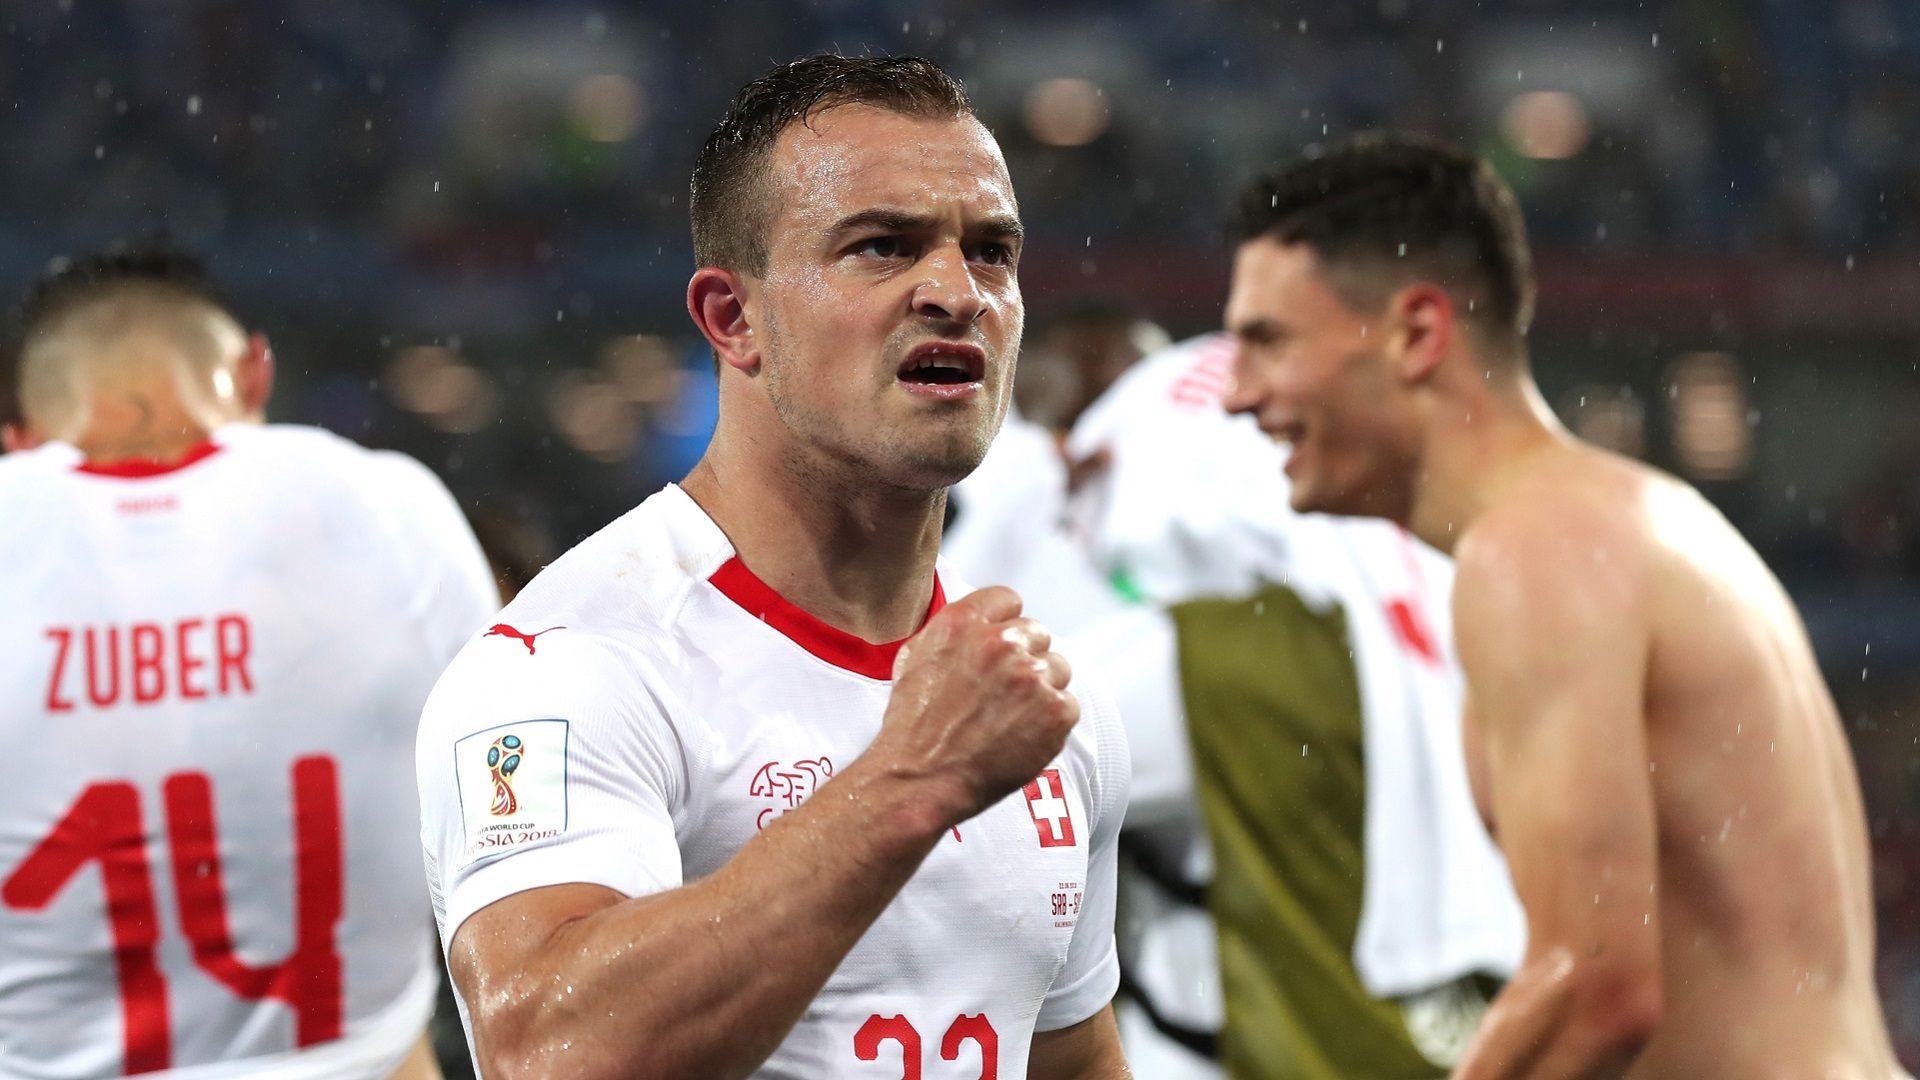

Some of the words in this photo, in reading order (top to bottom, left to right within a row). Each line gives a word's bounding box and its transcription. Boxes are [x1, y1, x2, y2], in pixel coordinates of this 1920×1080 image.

[44, 613, 254, 713] ZUBER
[490, 823, 518, 831] WORLD
[0, 753, 344, 1078] 14
[1051, 893, 1067, 915] SRB
